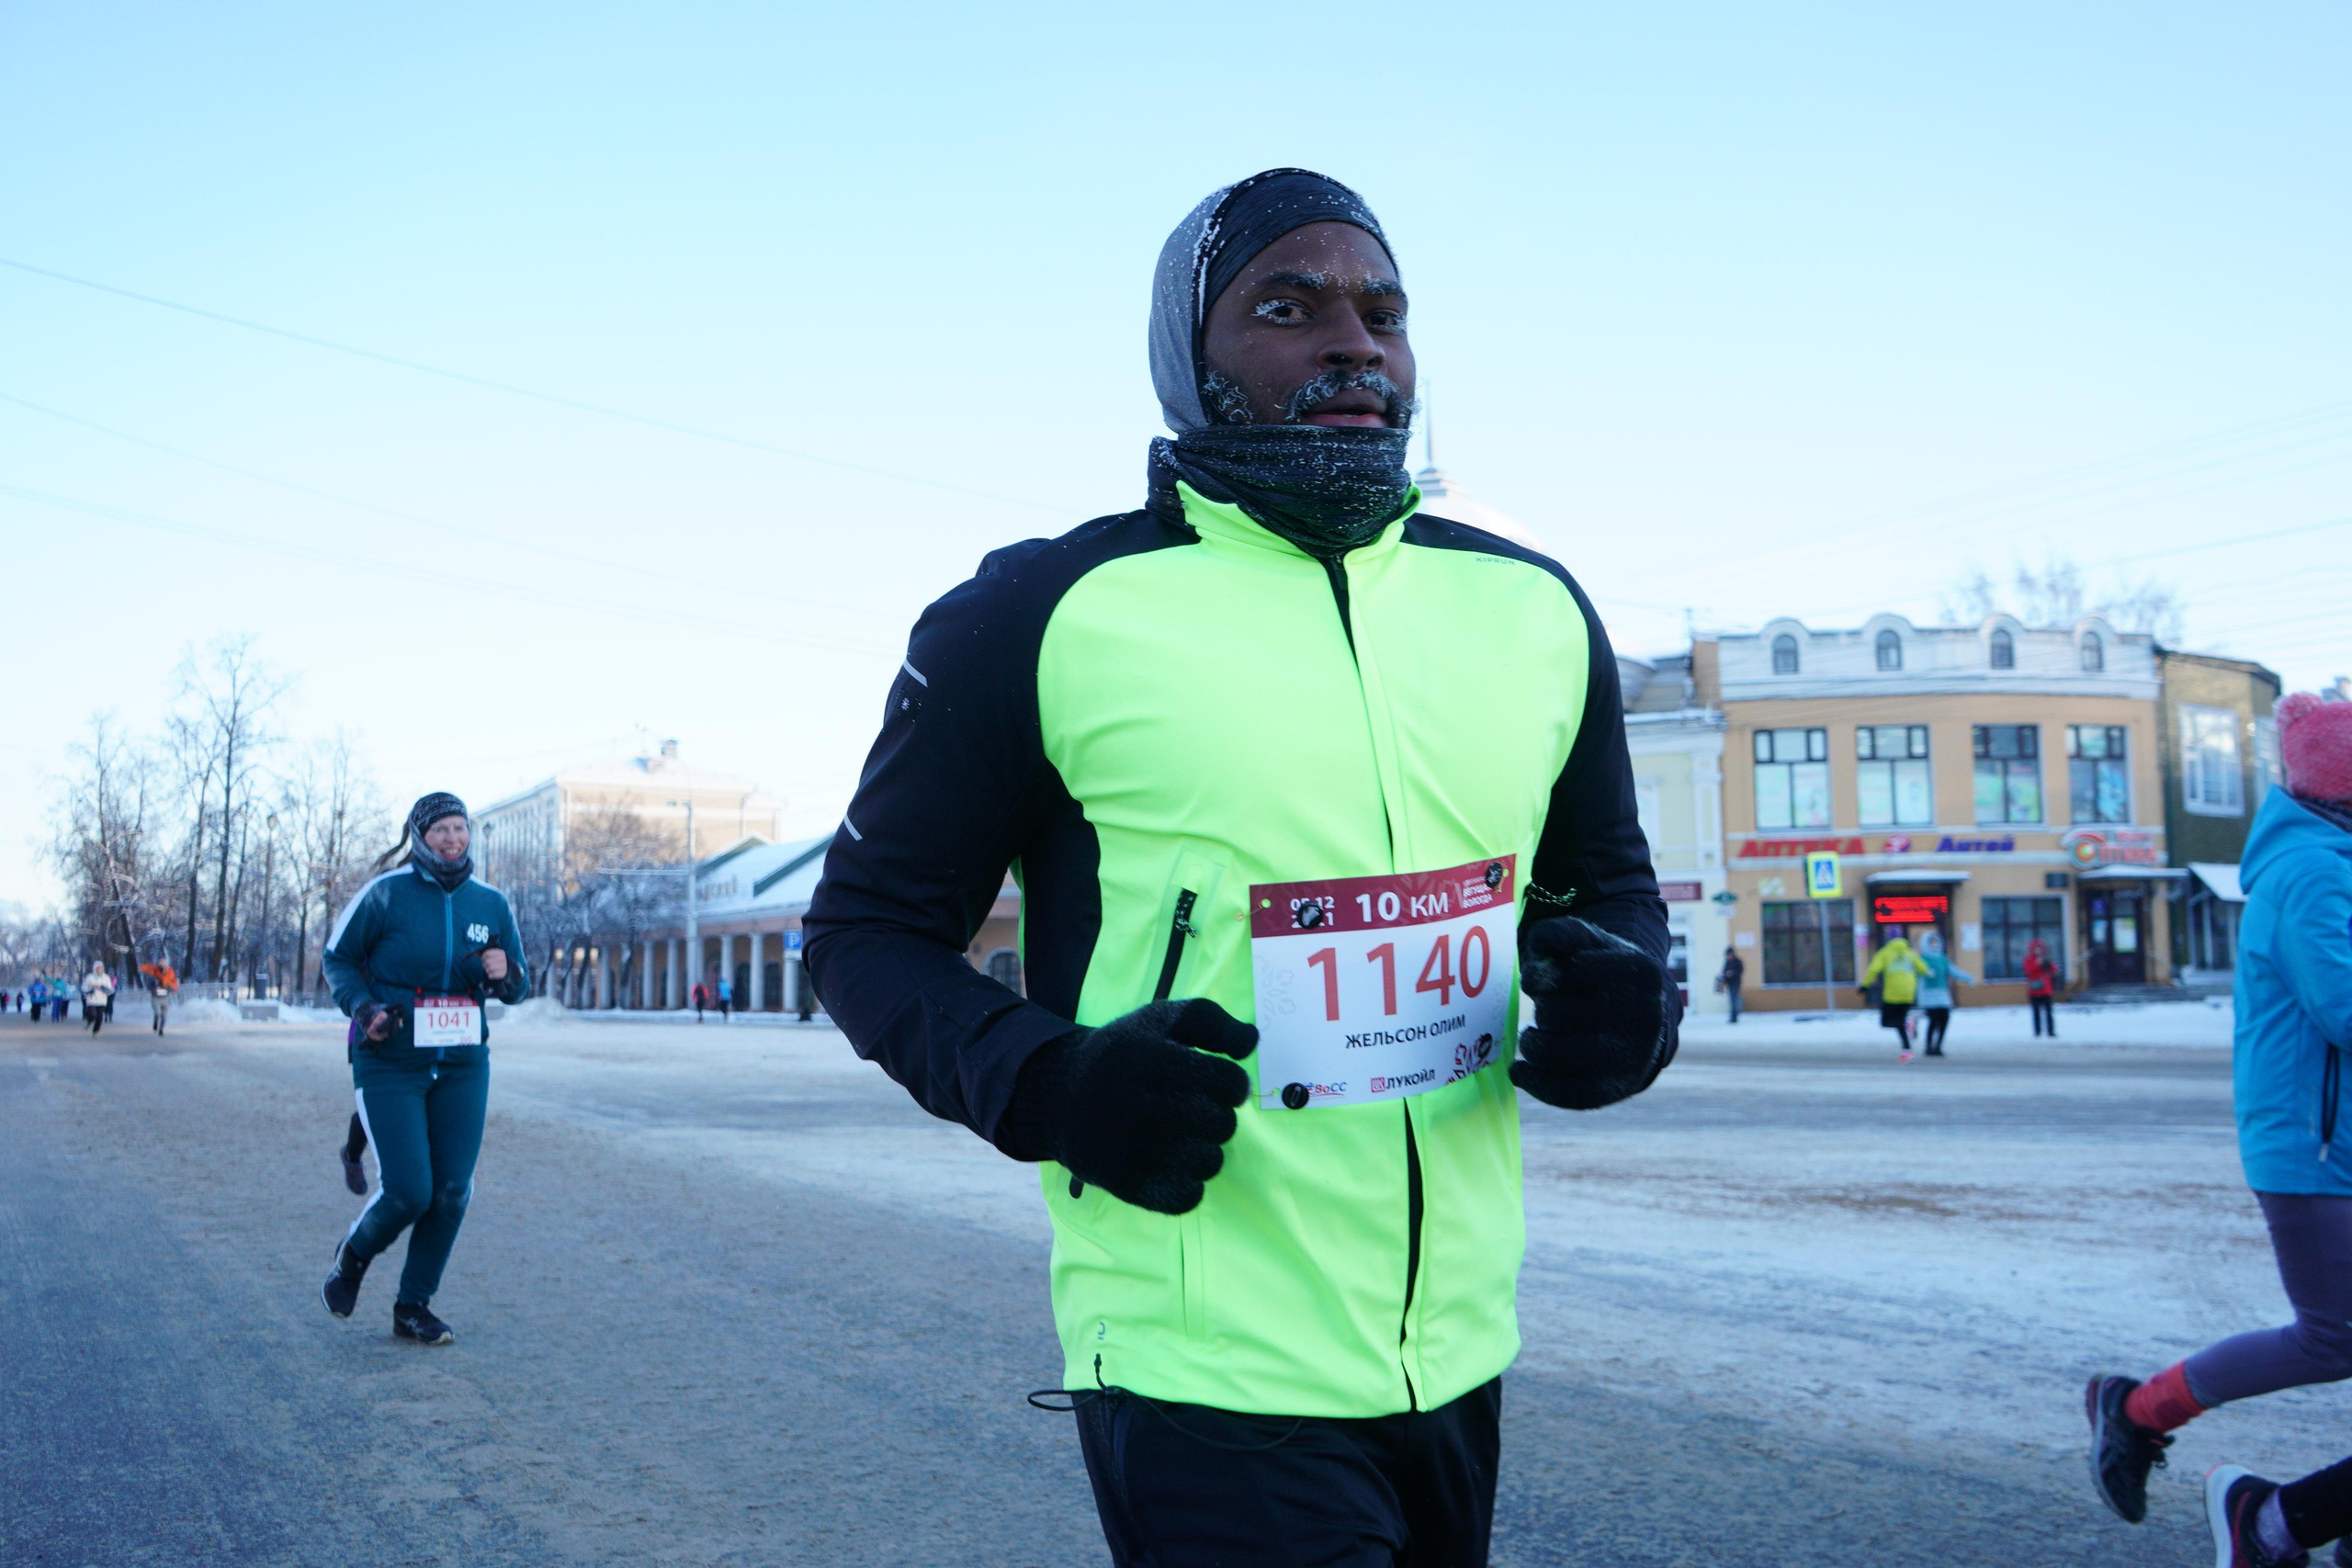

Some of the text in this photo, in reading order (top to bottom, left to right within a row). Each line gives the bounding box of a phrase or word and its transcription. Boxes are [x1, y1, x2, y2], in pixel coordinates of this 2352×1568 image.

[1476, 557, 1515, 565] KIPRUN
[1738, 837, 1864, 857] АПТЕКА
[1355, 891, 1400, 922] 10
[1410, 892, 1449, 918] КМ
[467, 922, 489, 943] 456
[1307, 925, 1490, 1021] 1140
[427, 1011, 469, 1028] 1041
[1345, 1014, 1466, 1049] ЖЕЛЬСОН ОЛИМ
[1386, 1068, 1435, 1089] ЛУКОЙЛ
